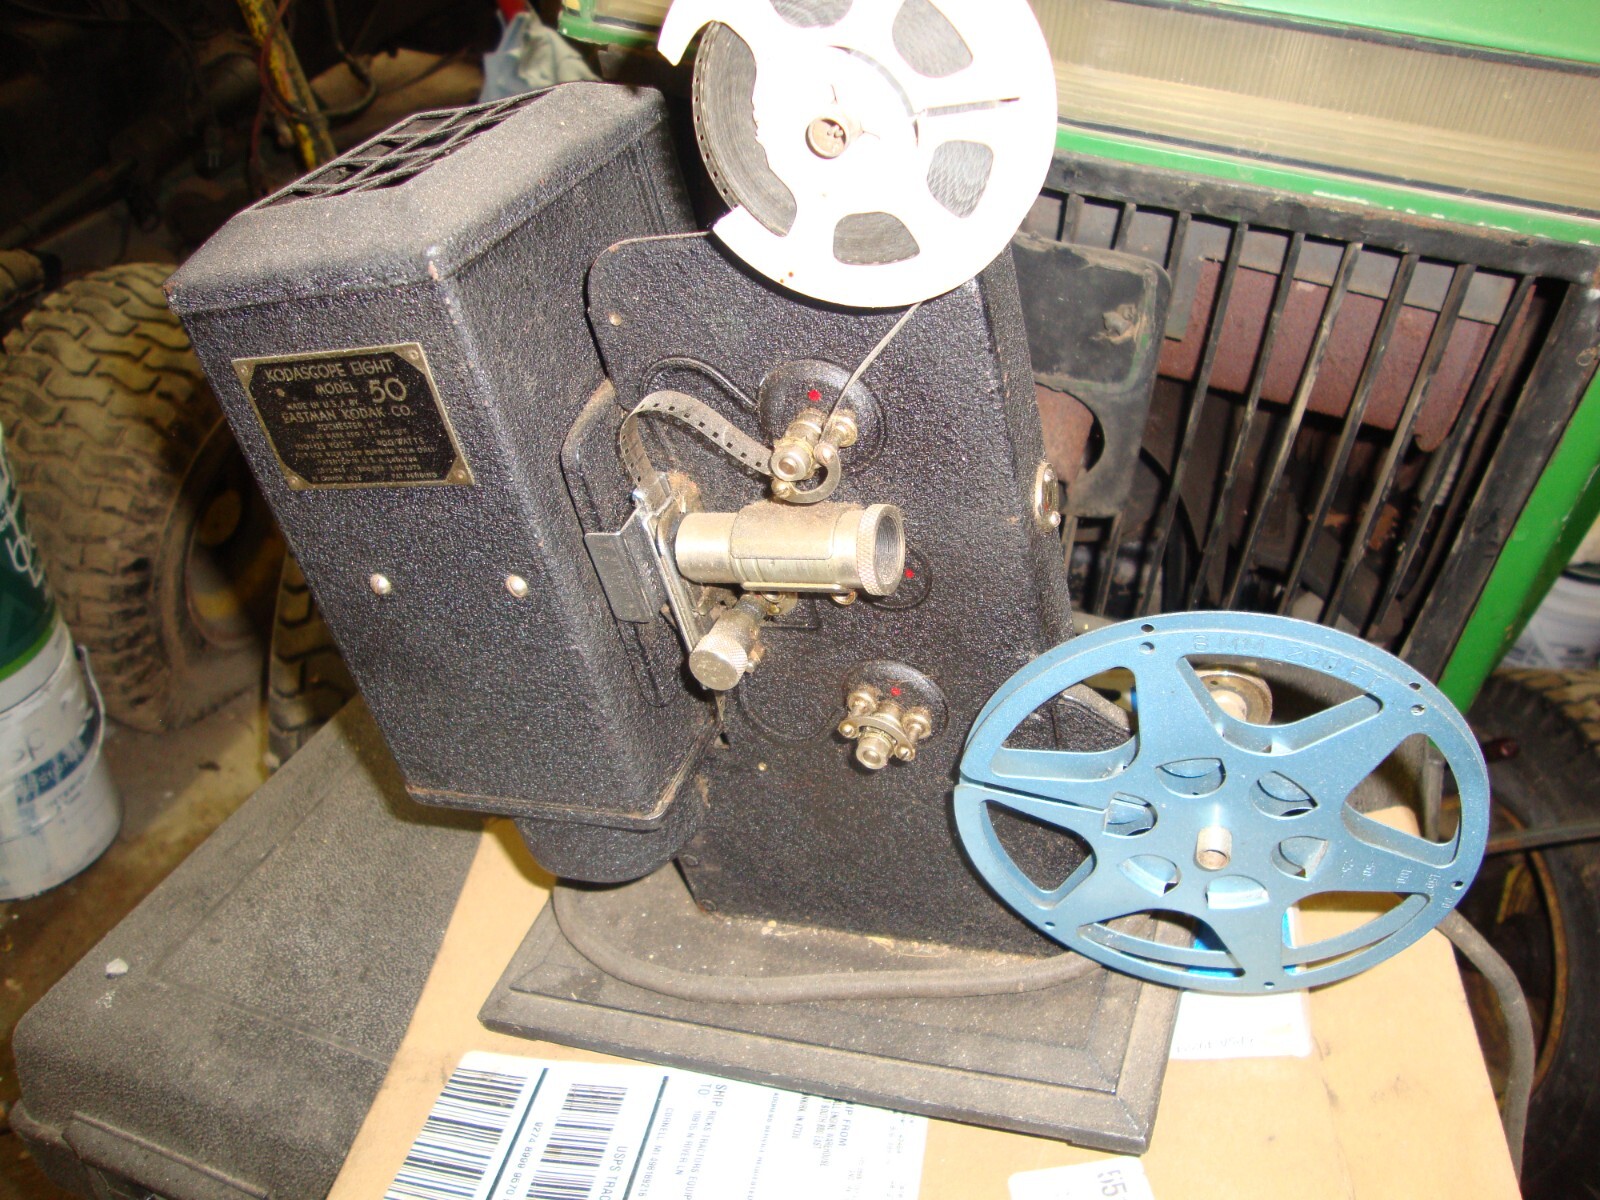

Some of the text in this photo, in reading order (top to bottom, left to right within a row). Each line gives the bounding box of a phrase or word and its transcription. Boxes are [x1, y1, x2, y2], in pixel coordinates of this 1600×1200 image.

[265, 359, 393, 383] KODASCOPE EIGHT
[316, 378, 407, 403] MODEL 50
[282, 411, 336, 423] EASTMAN
[342, 407, 385, 419] KODAK
[327, 440, 353, 448] VOLTS
[712, 1084, 728, 1107] SHIP
[704, 1111, 717, 1131] RICKS
[838, 1119, 852, 1147] FROM
[609, 1146, 628, 1172] USPS
[679, 1141, 693, 1162] RIVER
[691, 1135, 710, 1173] TRACTORS
[675, 1165, 686, 1176] LN
